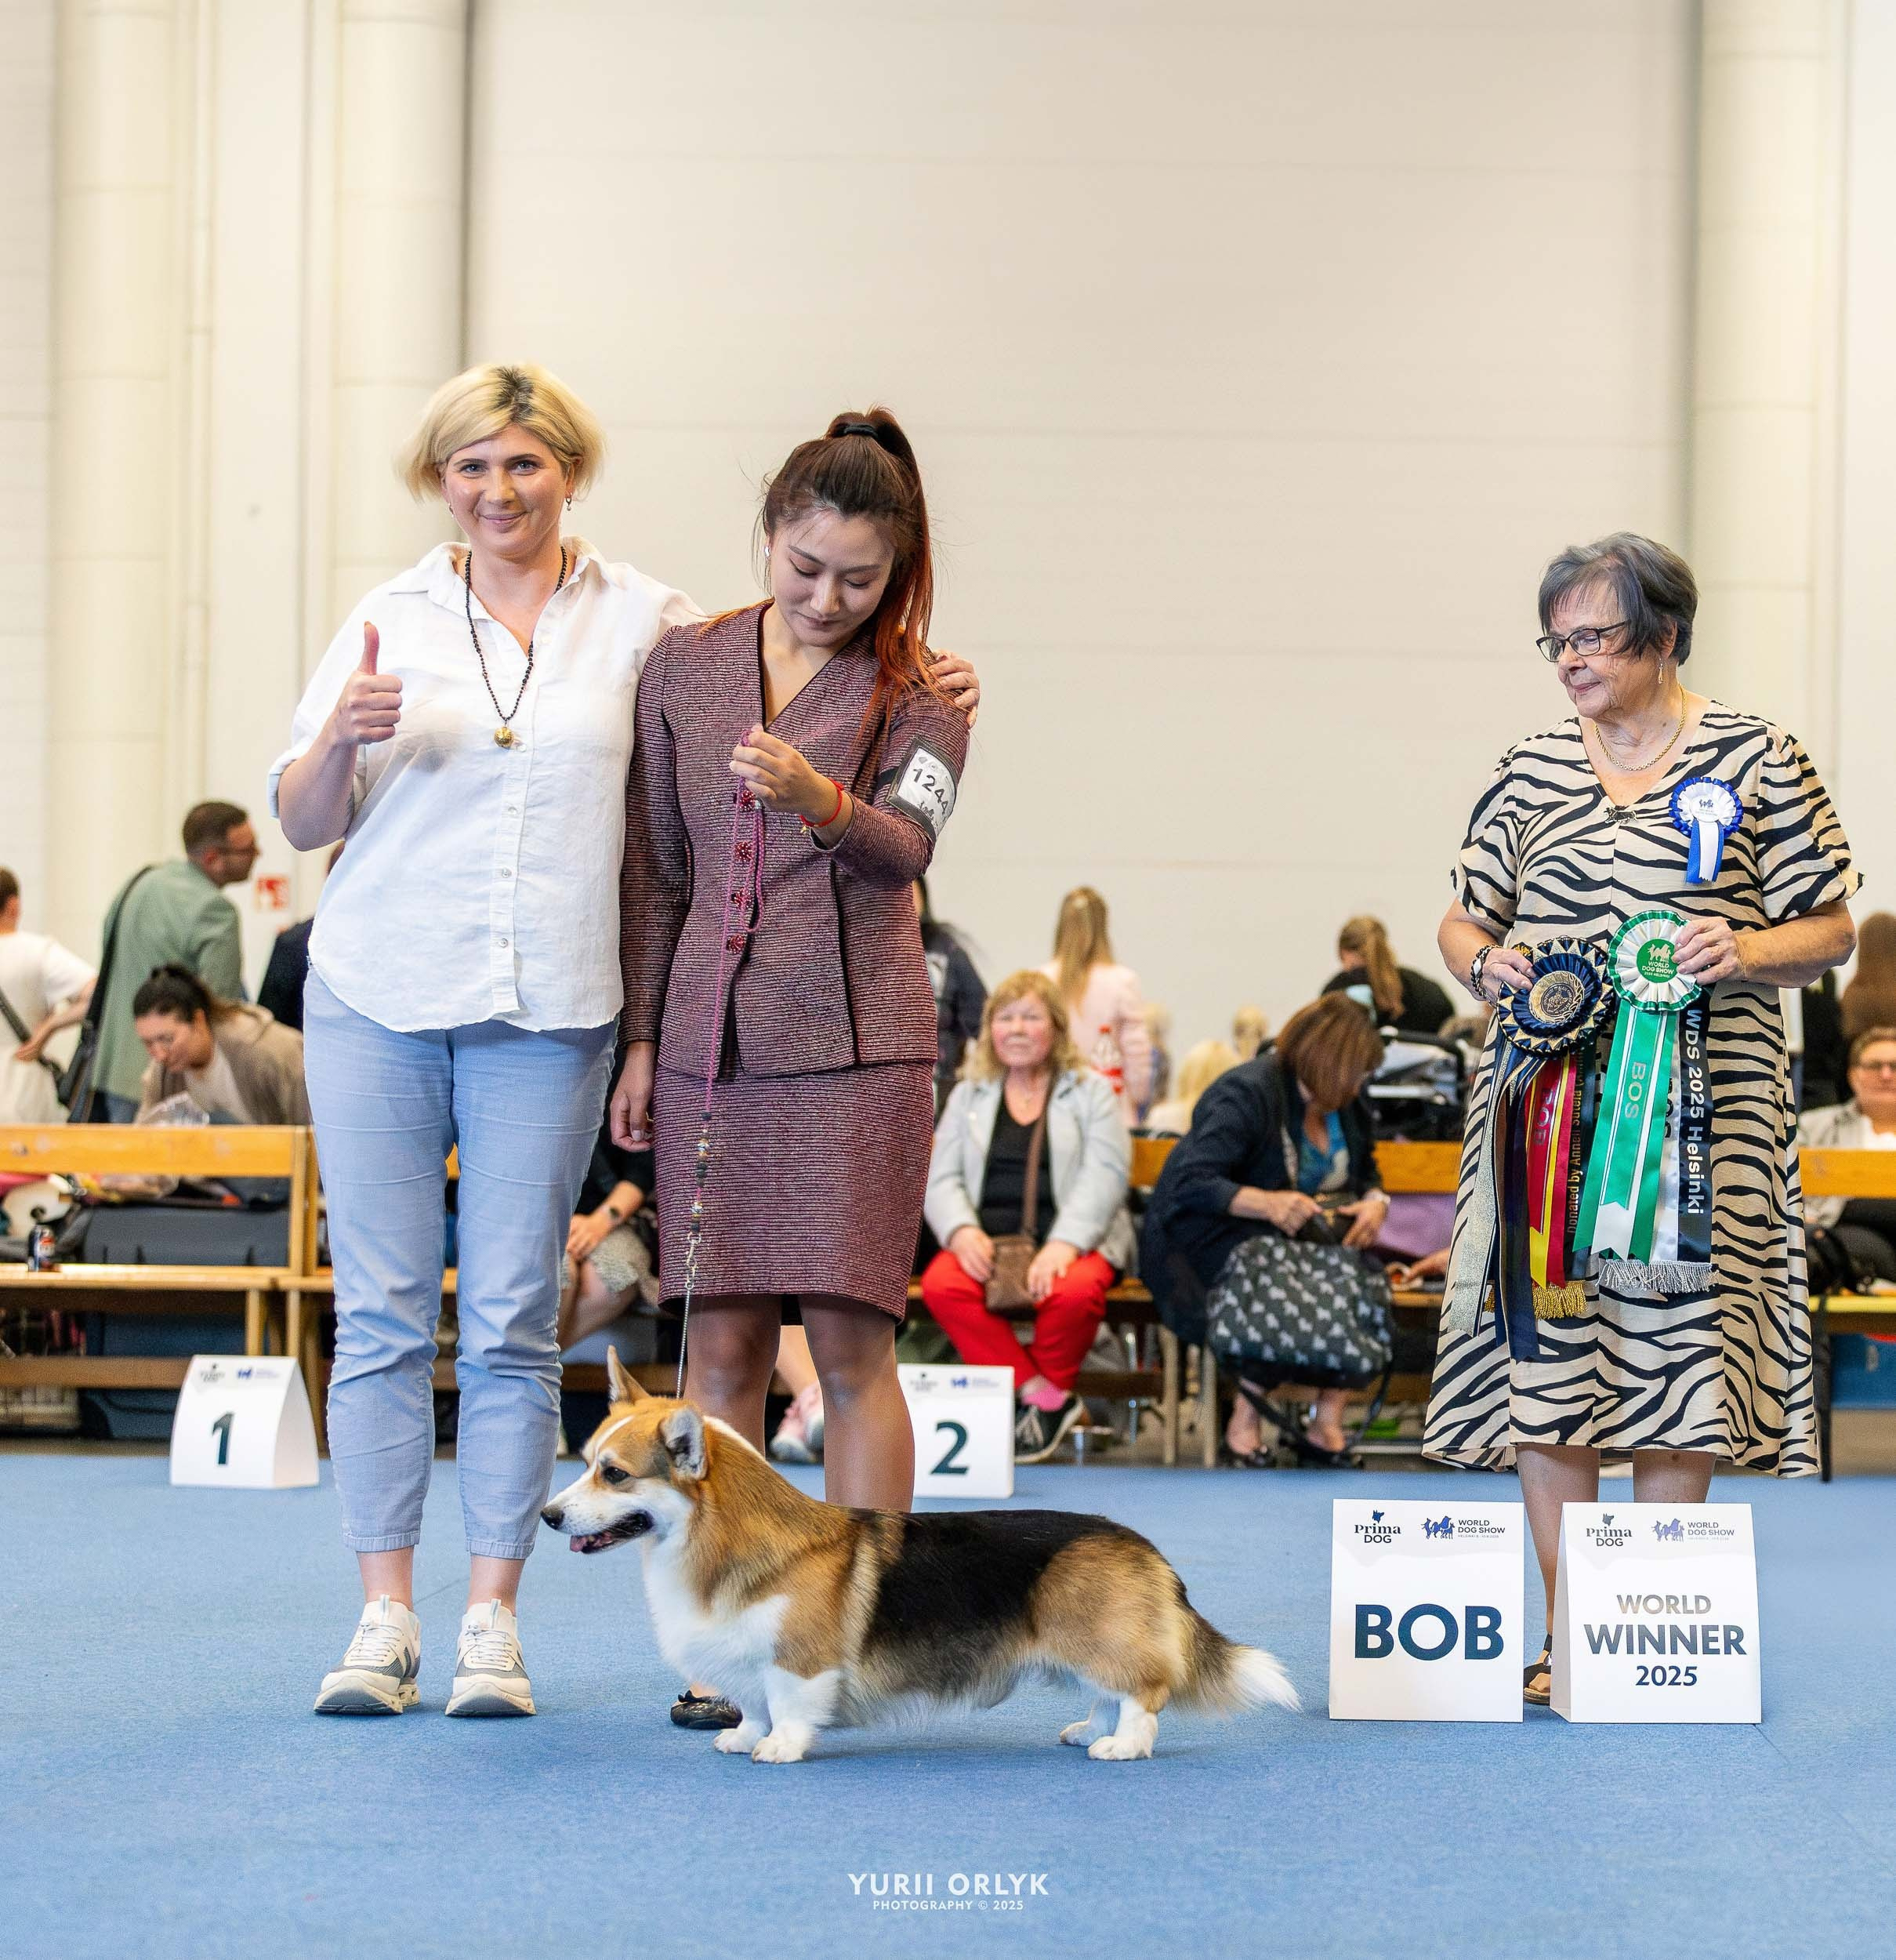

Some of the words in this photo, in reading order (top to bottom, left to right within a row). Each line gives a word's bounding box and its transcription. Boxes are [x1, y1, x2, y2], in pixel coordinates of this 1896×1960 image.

[1685, 1009, 1702, 1060] WDS
[1625, 1061, 1646, 1120] BOS
[1689, 1066, 1705, 1119] 2025
[1568, 1169, 1583, 1182] by
[1687, 1126, 1705, 1214] Helsinki
[1568, 1185, 1579, 1233] Donated
[212, 1411, 234, 1465] 1
[930, 1421, 969, 1475] 2
[1354, 1523, 1401, 1534] Prima
[1364, 1534, 1392, 1543] DOG
[1586, 1526, 1632, 1537] Prima
[1596, 1538, 1623, 1547] DOG
[1617, 1594, 1711, 1614] WORLD
[1354, 1603, 1504, 1661] BOB
[1583, 1624, 1746, 1655] WINNER
[1635, 1665, 1697, 1686] 2025
